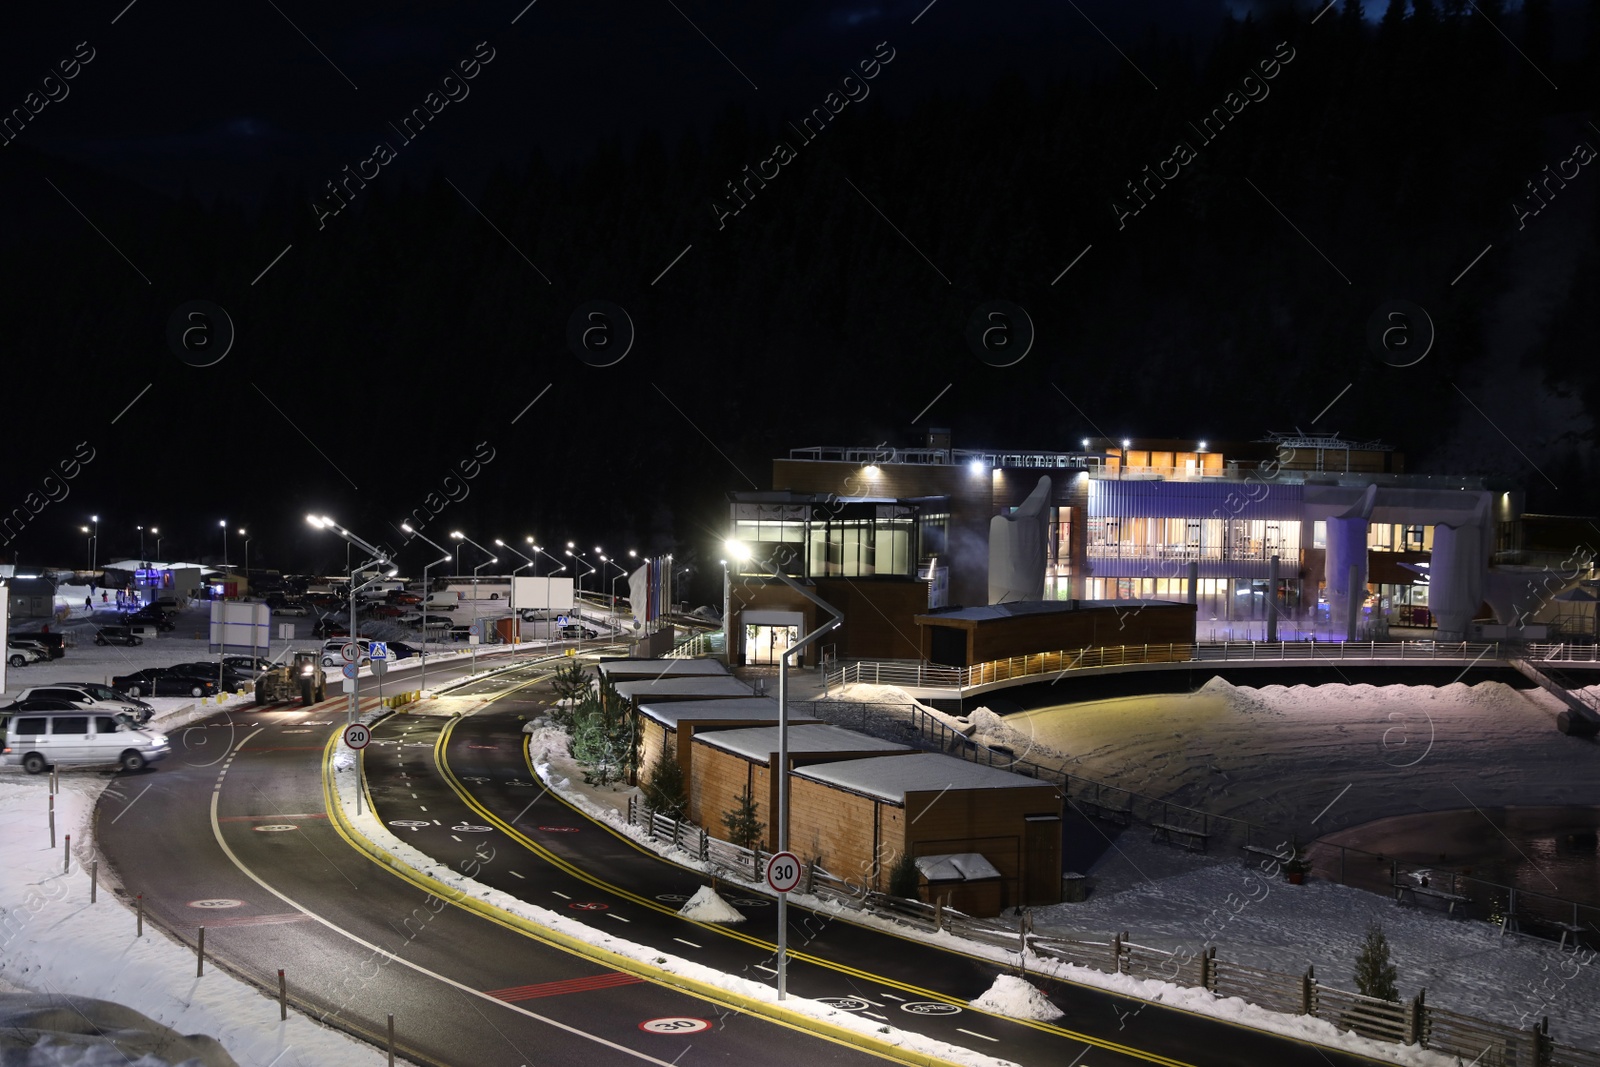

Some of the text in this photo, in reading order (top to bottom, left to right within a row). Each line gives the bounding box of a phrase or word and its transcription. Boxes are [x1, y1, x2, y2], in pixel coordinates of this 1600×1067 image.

[350, 732, 364, 742] 20
[775, 865, 793, 880] 30
[655, 1021, 695, 1031] 30
